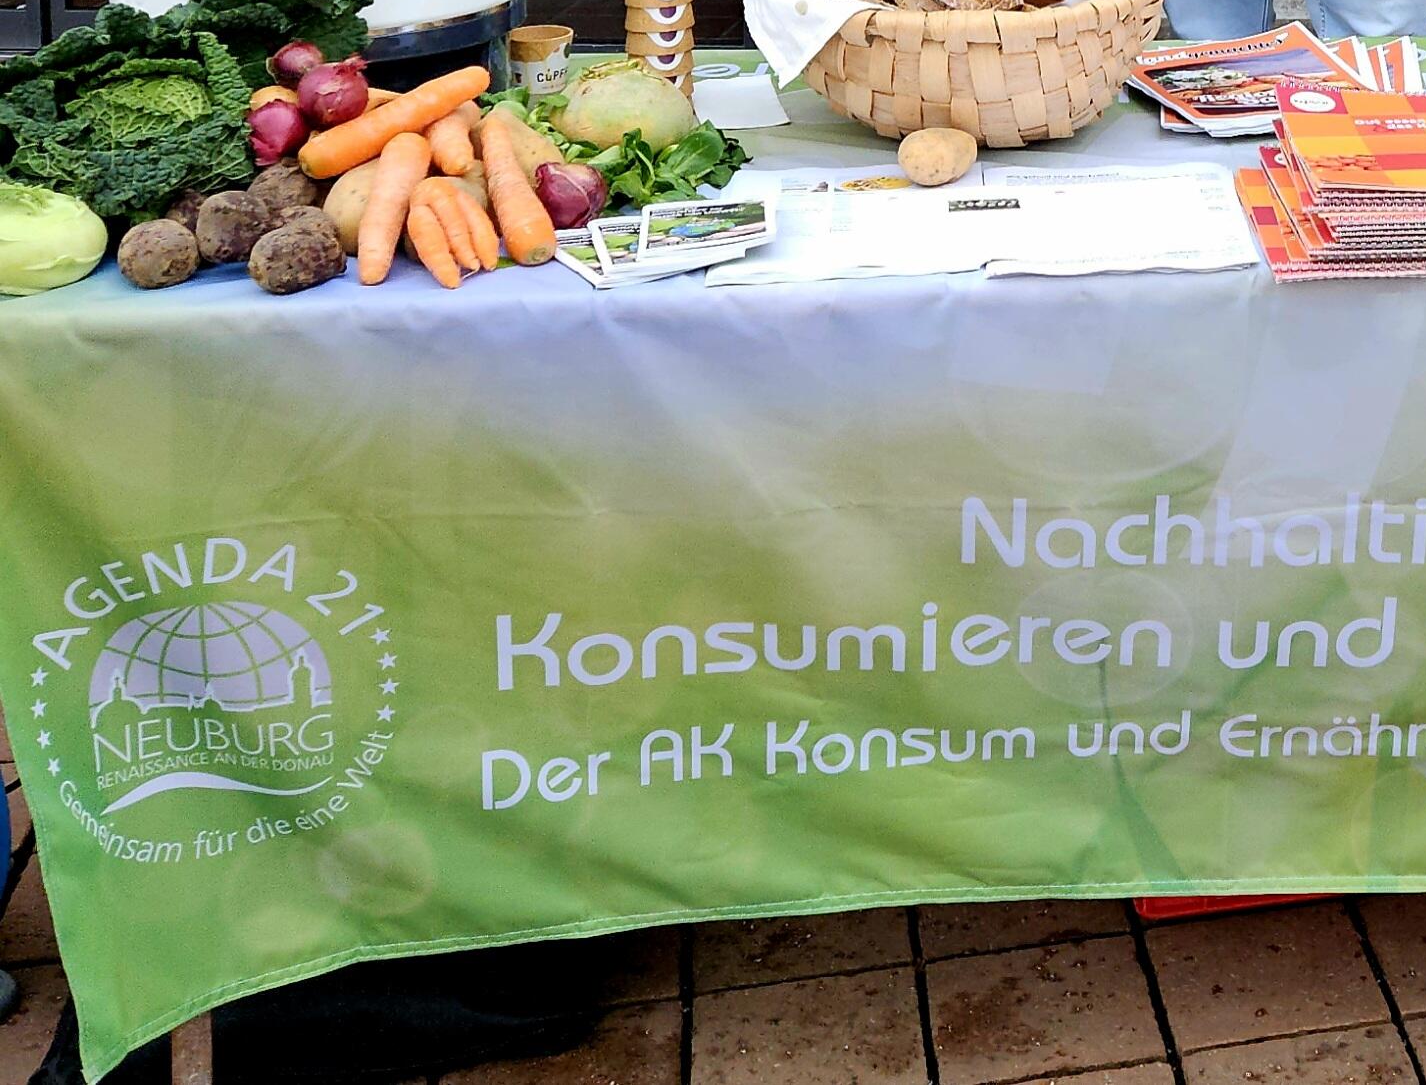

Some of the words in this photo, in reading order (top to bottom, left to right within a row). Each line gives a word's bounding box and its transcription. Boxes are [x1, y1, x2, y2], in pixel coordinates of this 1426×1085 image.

[32, 537, 296, 671] AGENDA
[305, 569, 385, 636] 21
[496, 601, 1173, 691] Konsumieren
[1217, 596, 1397, 669] und
[93, 714, 335, 773] NEUBURG
[97, 752, 209, 791] RENAISSANCE
[213, 753, 237, 766] AN
[240, 755, 270, 771] DER
[272, 751, 335, 772] DONAU
[481, 749, 611, 811] Der
[640, 723, 735, 787] AK
[766, 719, 1036, 776] Konsum
[1067, 710, 1192, 758] und
[59, 780, 183, 864] Gemeinsam
[194, 828, 239, 860] für
[246, 815, 294, 844] die
[295, 792, 349, 831] eine
[336, 729, 395, 790] Welt
